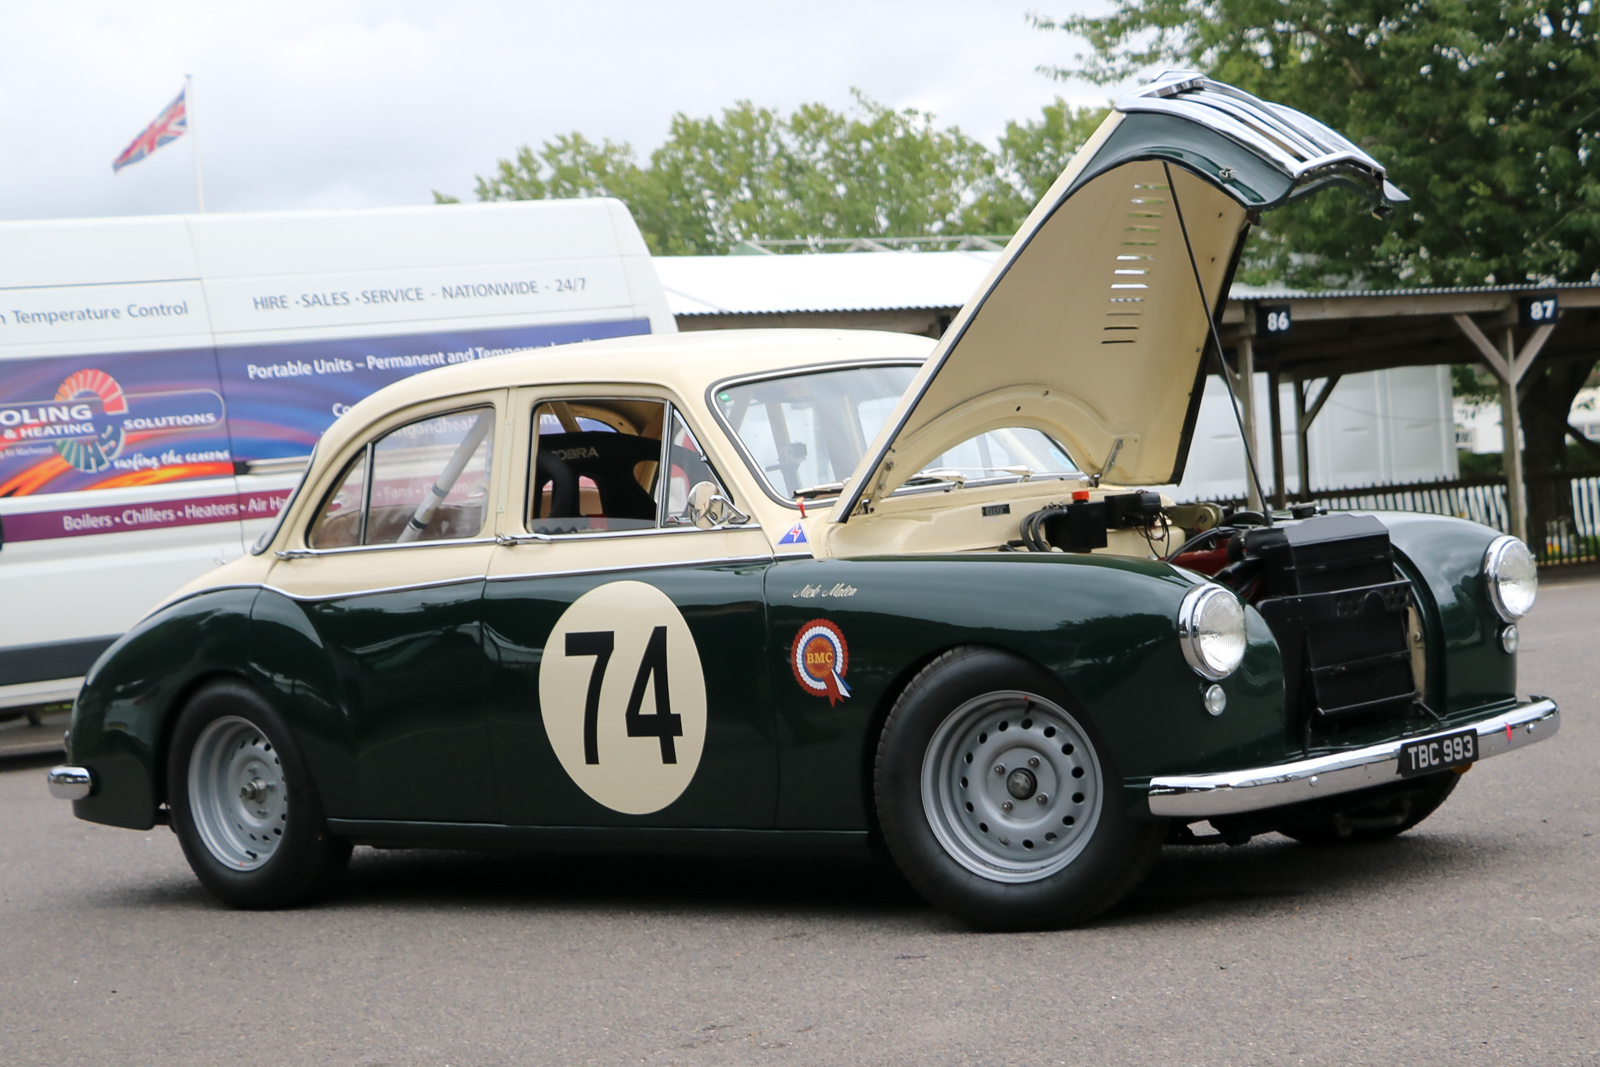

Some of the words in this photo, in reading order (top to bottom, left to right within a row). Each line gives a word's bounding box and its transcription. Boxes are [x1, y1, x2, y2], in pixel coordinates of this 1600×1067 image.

[253, 295, 288, 310] HIRE
[301, 291, 350, 307] SALES
[361, 287, 424, 304] SERVICE
[441, 280, 540, 300] NATIONWIDE
[554, 277, 588, 293] 24/7
[11, 306, 121, 326] Temperature
[126, 300, 189, 318] Control
[1267, 312, 1290, 331] 86
[1530, 300, 1555, 320] 87
[247, 361, 311, 381] Portable
[313, 358, 353, 375] Units
[367, 351, 446, 371] Permanent
[447, 347, 475, 362] and
[20, 422, 95, 438] HEATING
[123, 413, 216, 430] SOLUTIONS
[114, 453, 158, 471] surfing
[161, 449, 183, 466] the
[185, 449, 230, 462] seasons
[63, 514, 113, 531] Boilers
[121, 507, 175, 526] Chillers
[185, 502, 238, 520] Heaters
[248, 496, 268, 513] Air
[807, 651, 833, 664] BMC
[565, 626, 683, 765] 74
[1408, 742, 1440, 770] TBC
[1443, 735, 1473, 762] 993
